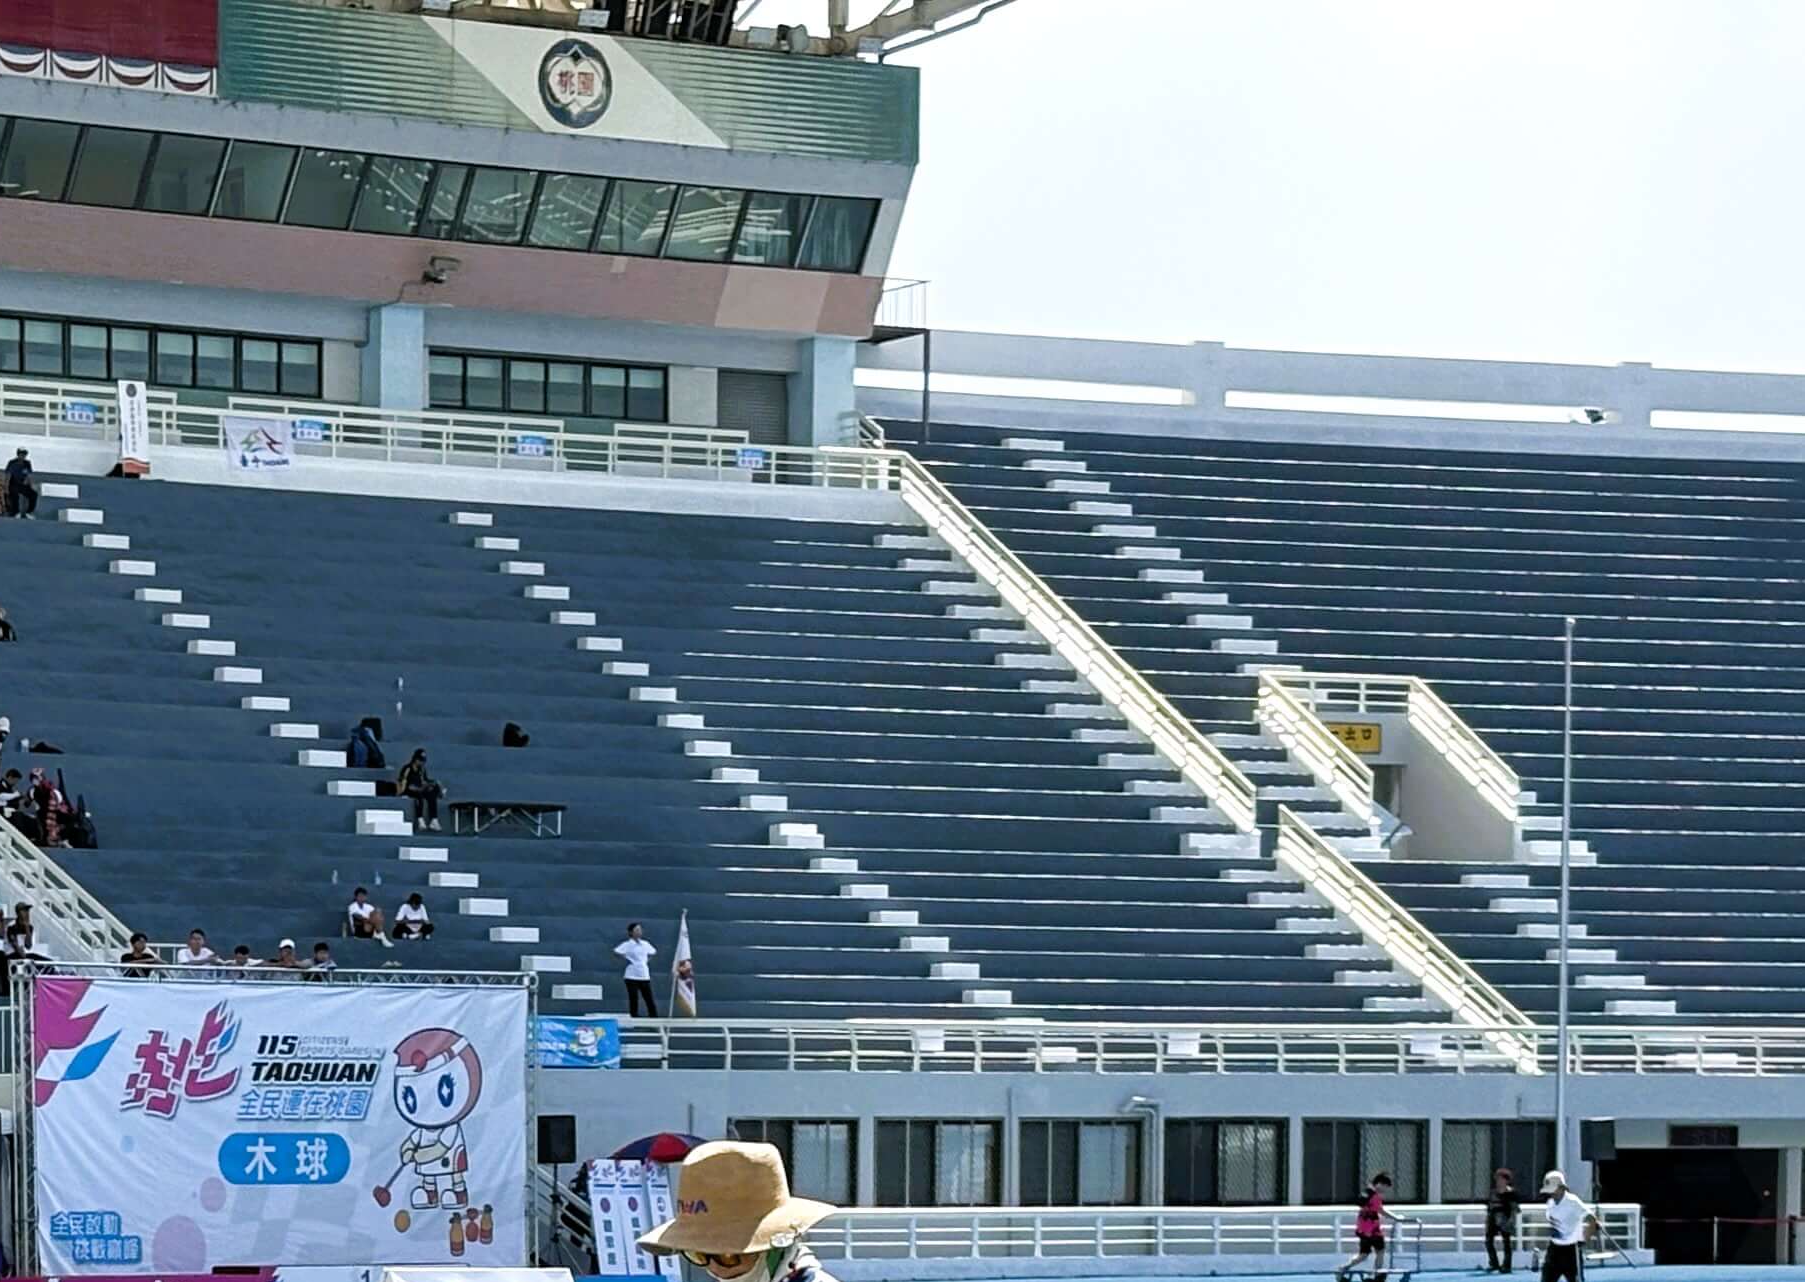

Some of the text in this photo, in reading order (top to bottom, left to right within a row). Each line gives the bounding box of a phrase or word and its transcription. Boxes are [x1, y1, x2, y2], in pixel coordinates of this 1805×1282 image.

[257, 1035, 299, 1055] 115
[251, 1062, 378, 1082] TAOYUAN
[237, 1089, 370, 1117] 全民運在桃園
[244, 1137, 329, 1181] 木球
